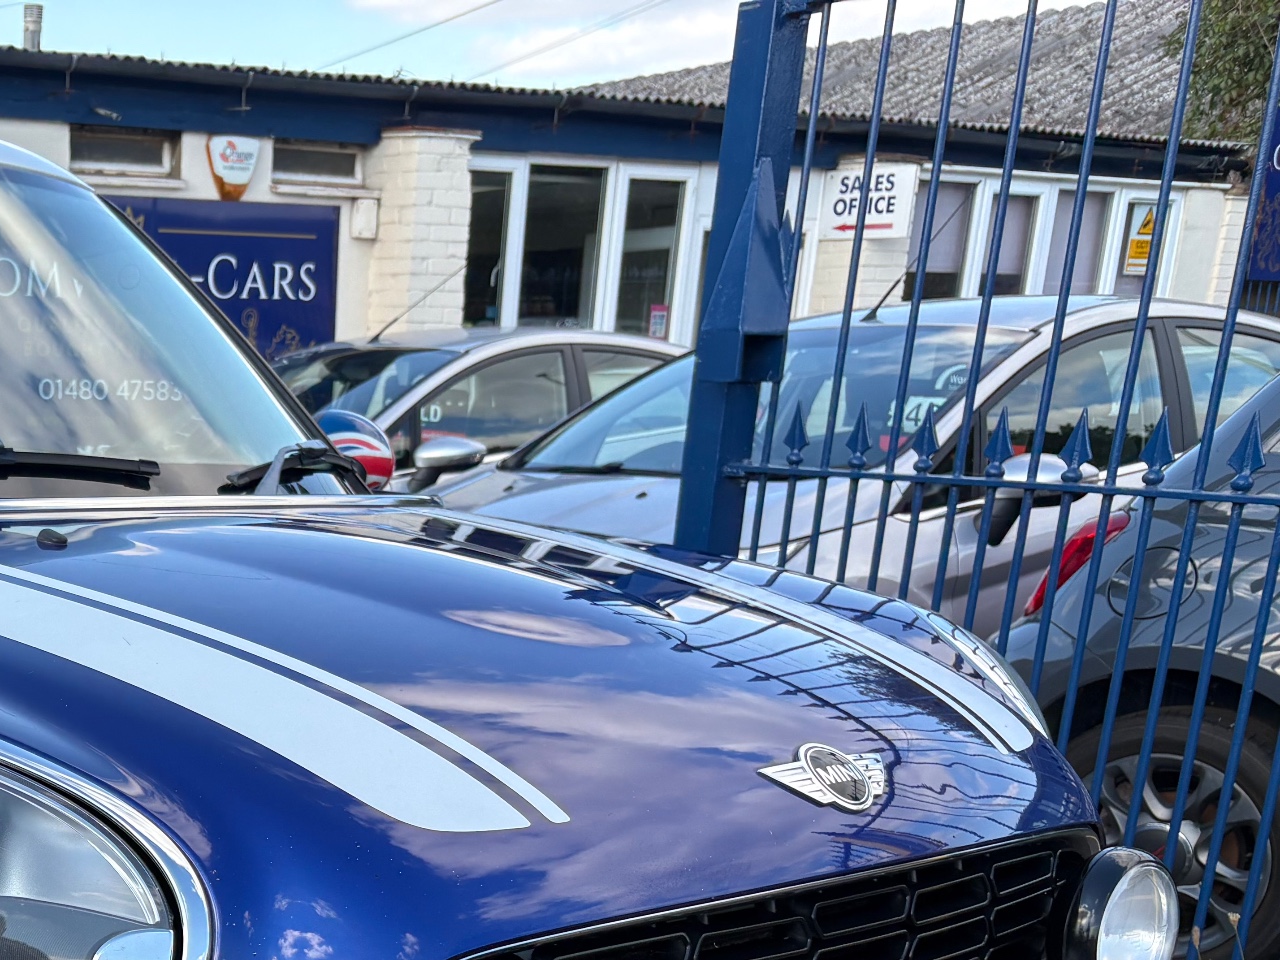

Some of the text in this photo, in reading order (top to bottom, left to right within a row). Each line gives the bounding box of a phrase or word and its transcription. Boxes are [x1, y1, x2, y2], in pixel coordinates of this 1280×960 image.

[839, 173, 896, 194] SAES
[833, 195, 897, 216] OFICE
[38, 378, 183, 401] 01480 47583
[421, 404, 442, 423] LD
[816, 763, 863, 785] MINI
